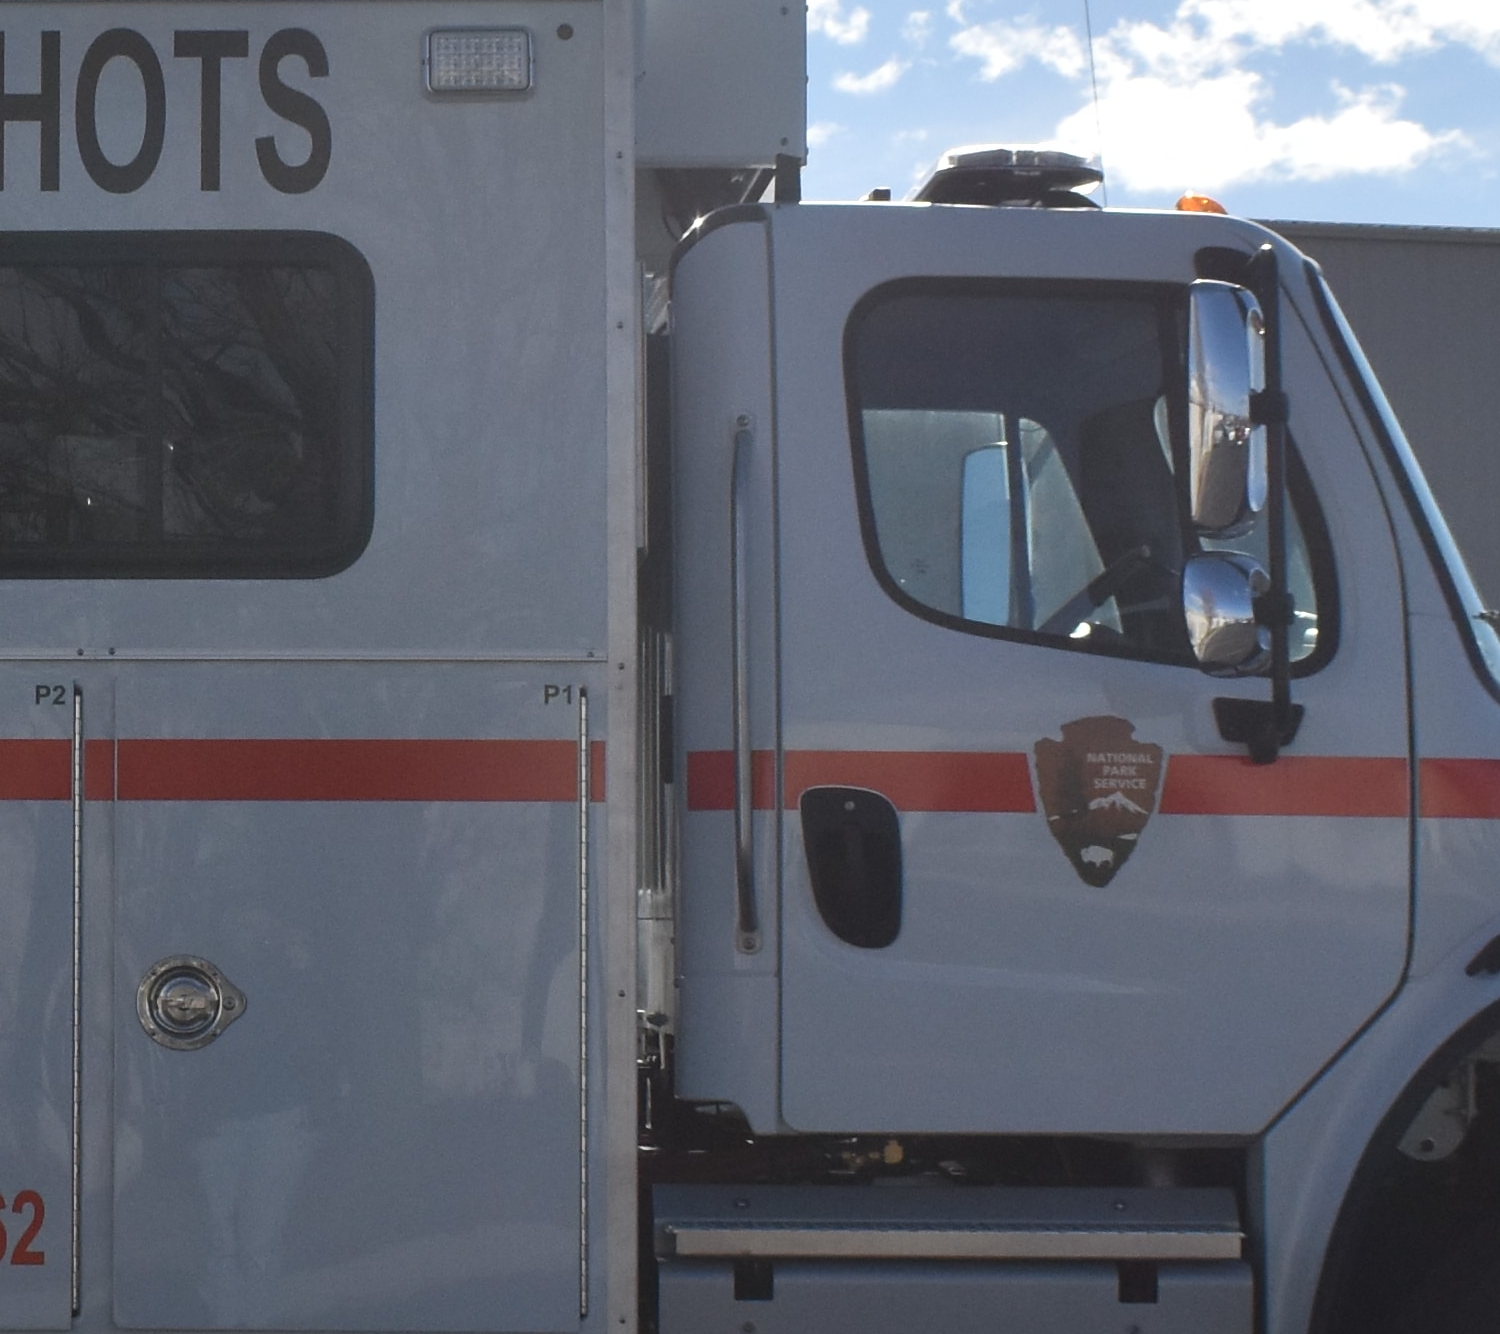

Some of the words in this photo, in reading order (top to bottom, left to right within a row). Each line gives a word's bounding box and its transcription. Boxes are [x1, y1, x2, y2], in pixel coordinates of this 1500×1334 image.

[35, 684, 66, 705] P2
[544, 684, 572, 705] P1
[1086, 753, 1154, 764] NATIONAL
[1102, 765, 1138, 776] PARK
[1094, 778, 1147, 789] SERVICE
